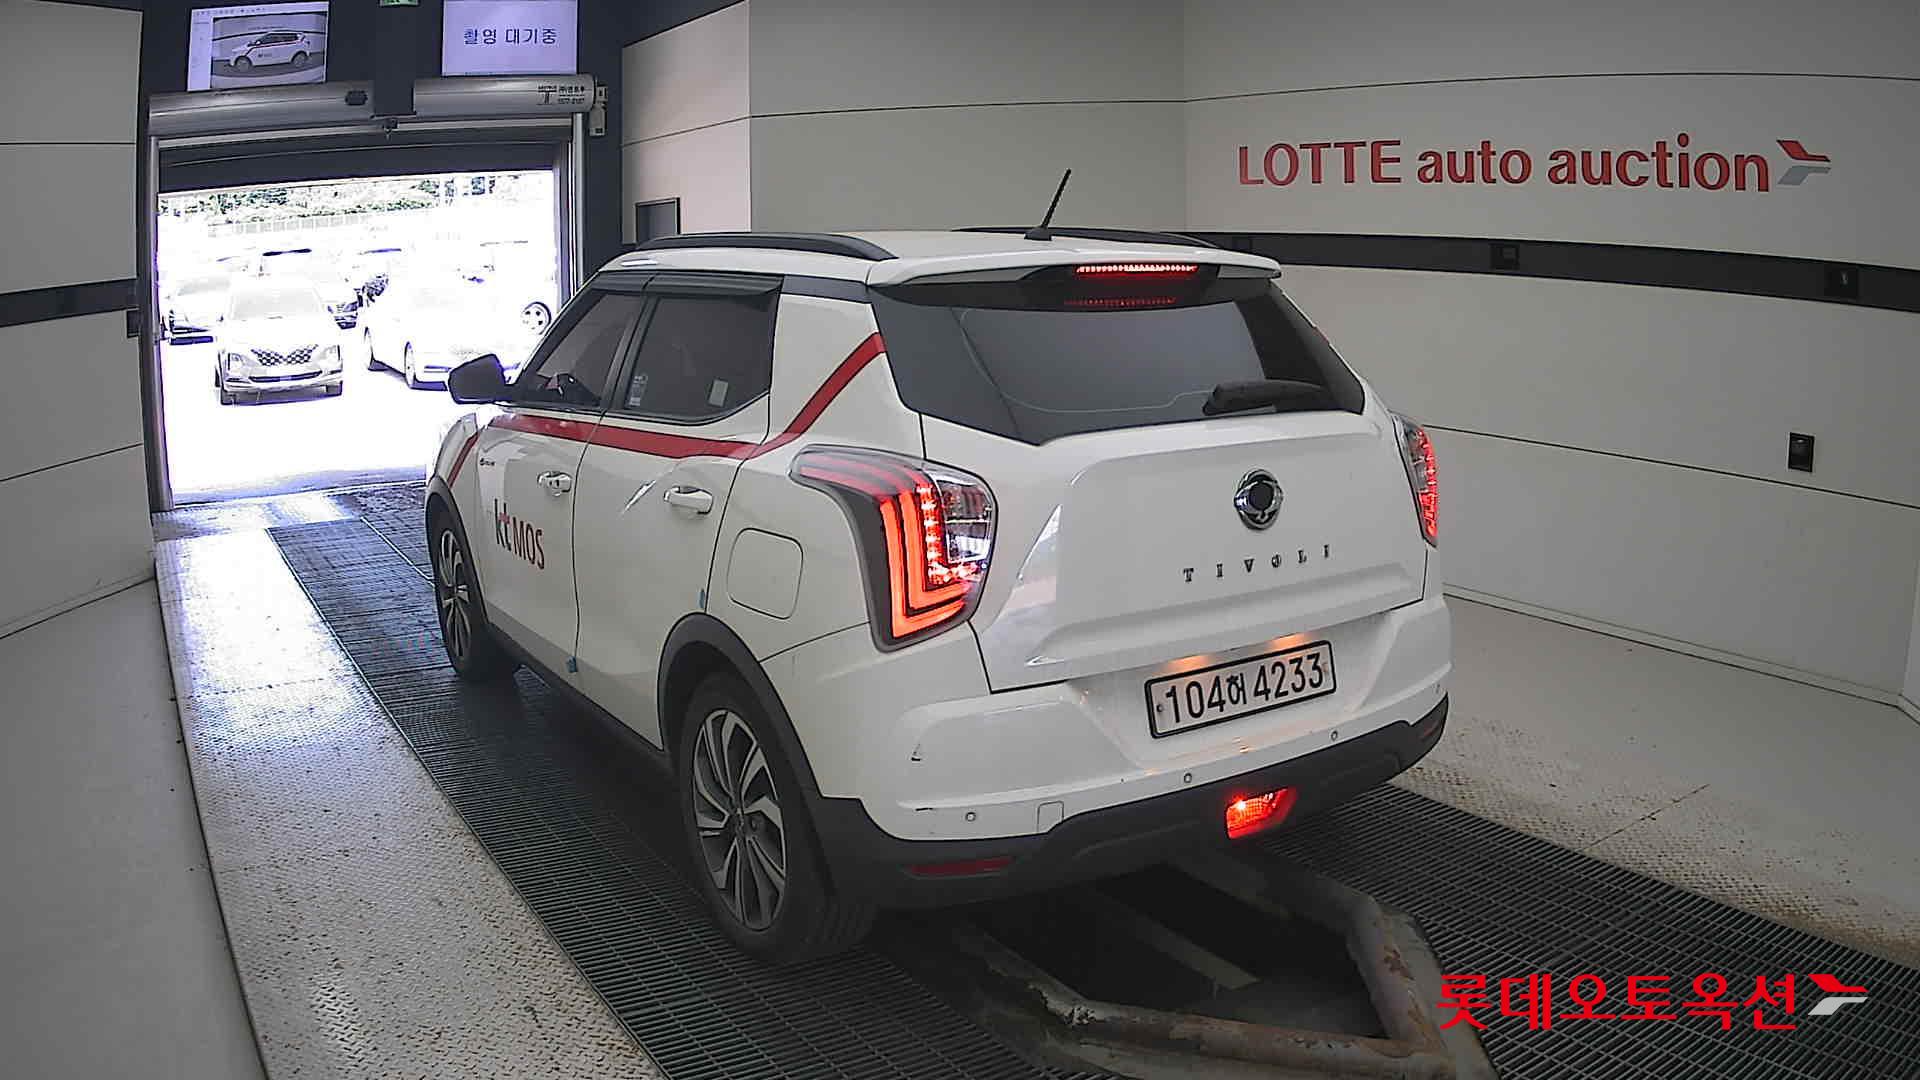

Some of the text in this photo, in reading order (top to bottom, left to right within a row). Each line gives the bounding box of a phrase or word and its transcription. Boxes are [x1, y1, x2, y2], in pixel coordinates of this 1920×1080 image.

[505, 28, 558, 45] 대기중
[1238, 132, 1770, 192] LOTTE auto auction
[512, 516, 545, 570] MOS
[1182, 544, 1330, 583] TIVOLI
[1253, 652, 1324, 702] 4233
